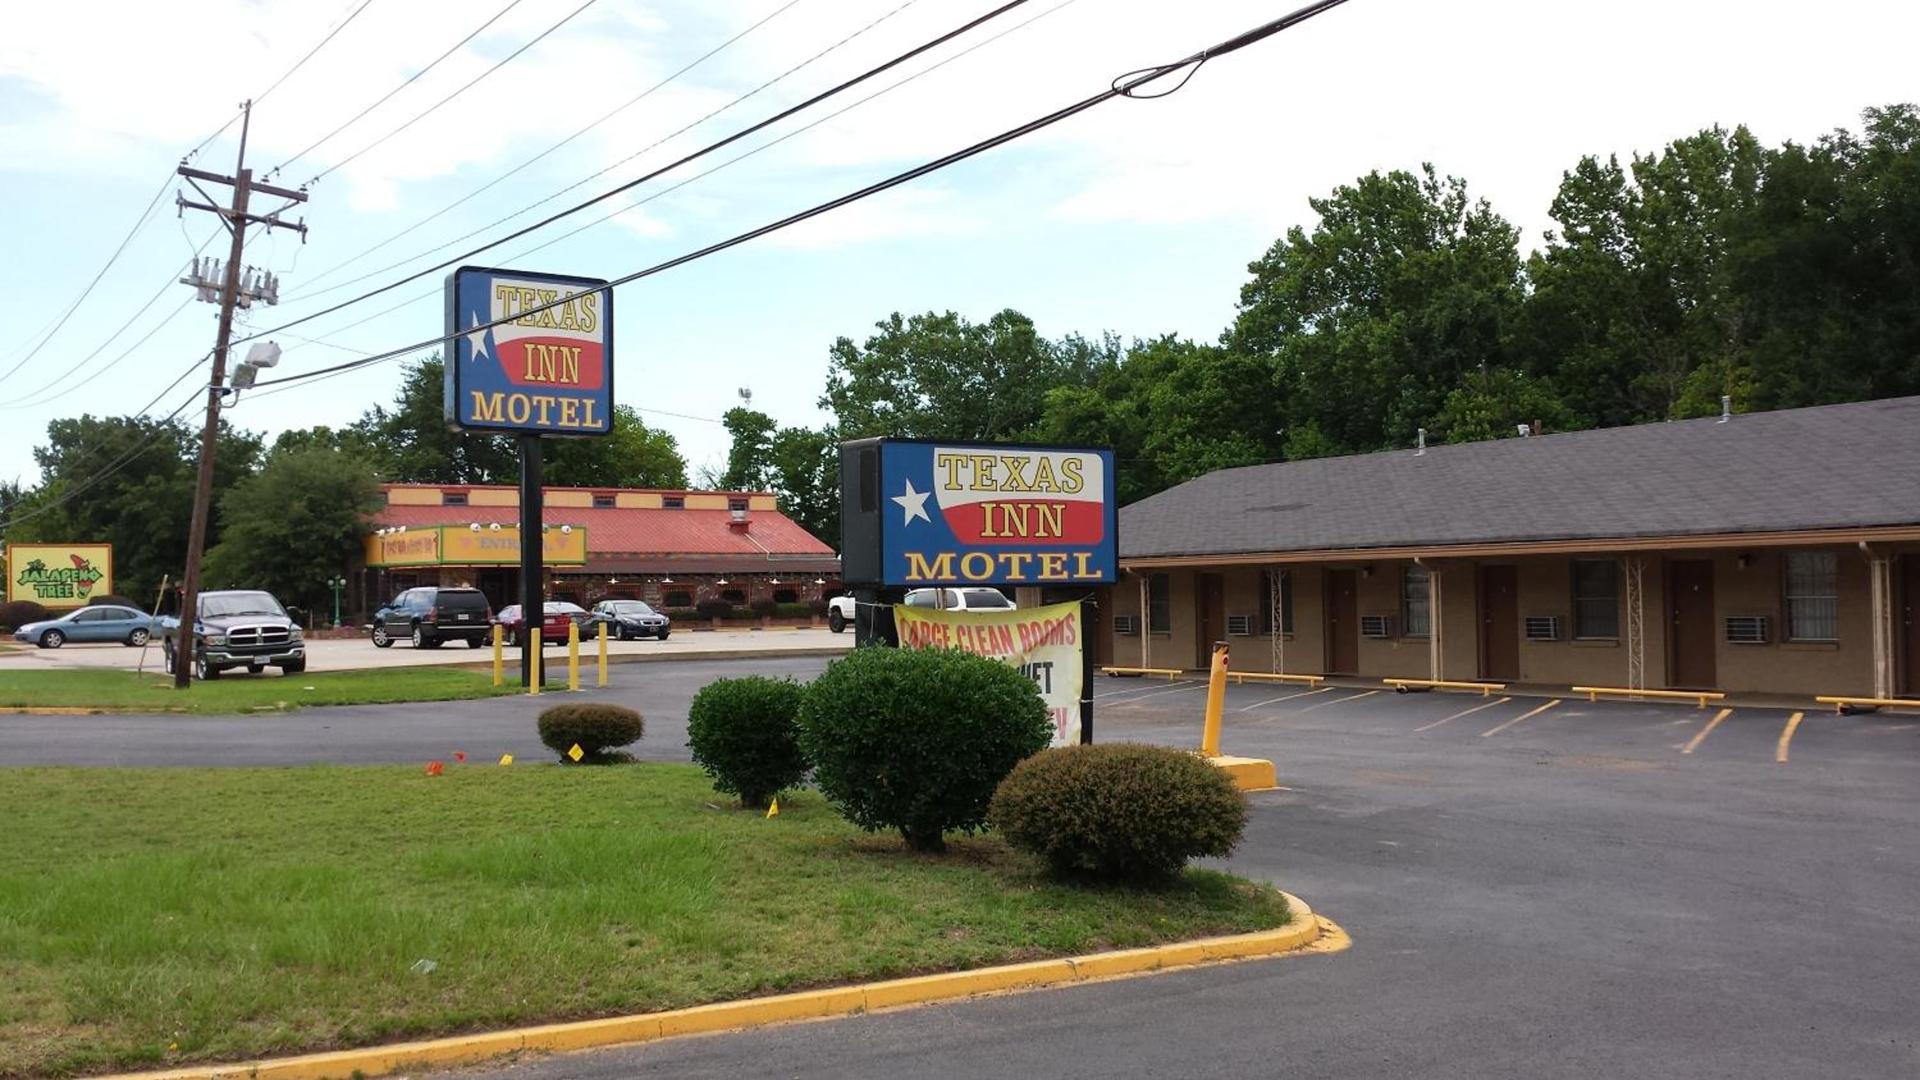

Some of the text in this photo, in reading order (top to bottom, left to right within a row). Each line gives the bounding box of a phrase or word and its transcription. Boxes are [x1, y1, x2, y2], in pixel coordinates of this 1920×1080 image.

[496, 284, 597, 334] TEXAS
[523, 343, 582, 385] INN
[470, 390, 604, 429] MOTEL
[937, 453, 1085, 494] TEXAS
[979, 502, 1067, 538] INN
[903, 551, 1103, 582] MOTEL
[33, 584, 74, 598] TREE
[956, 622, 1016, 656] CLEAN
[1016, 611, 1076, 653] ROOMS
